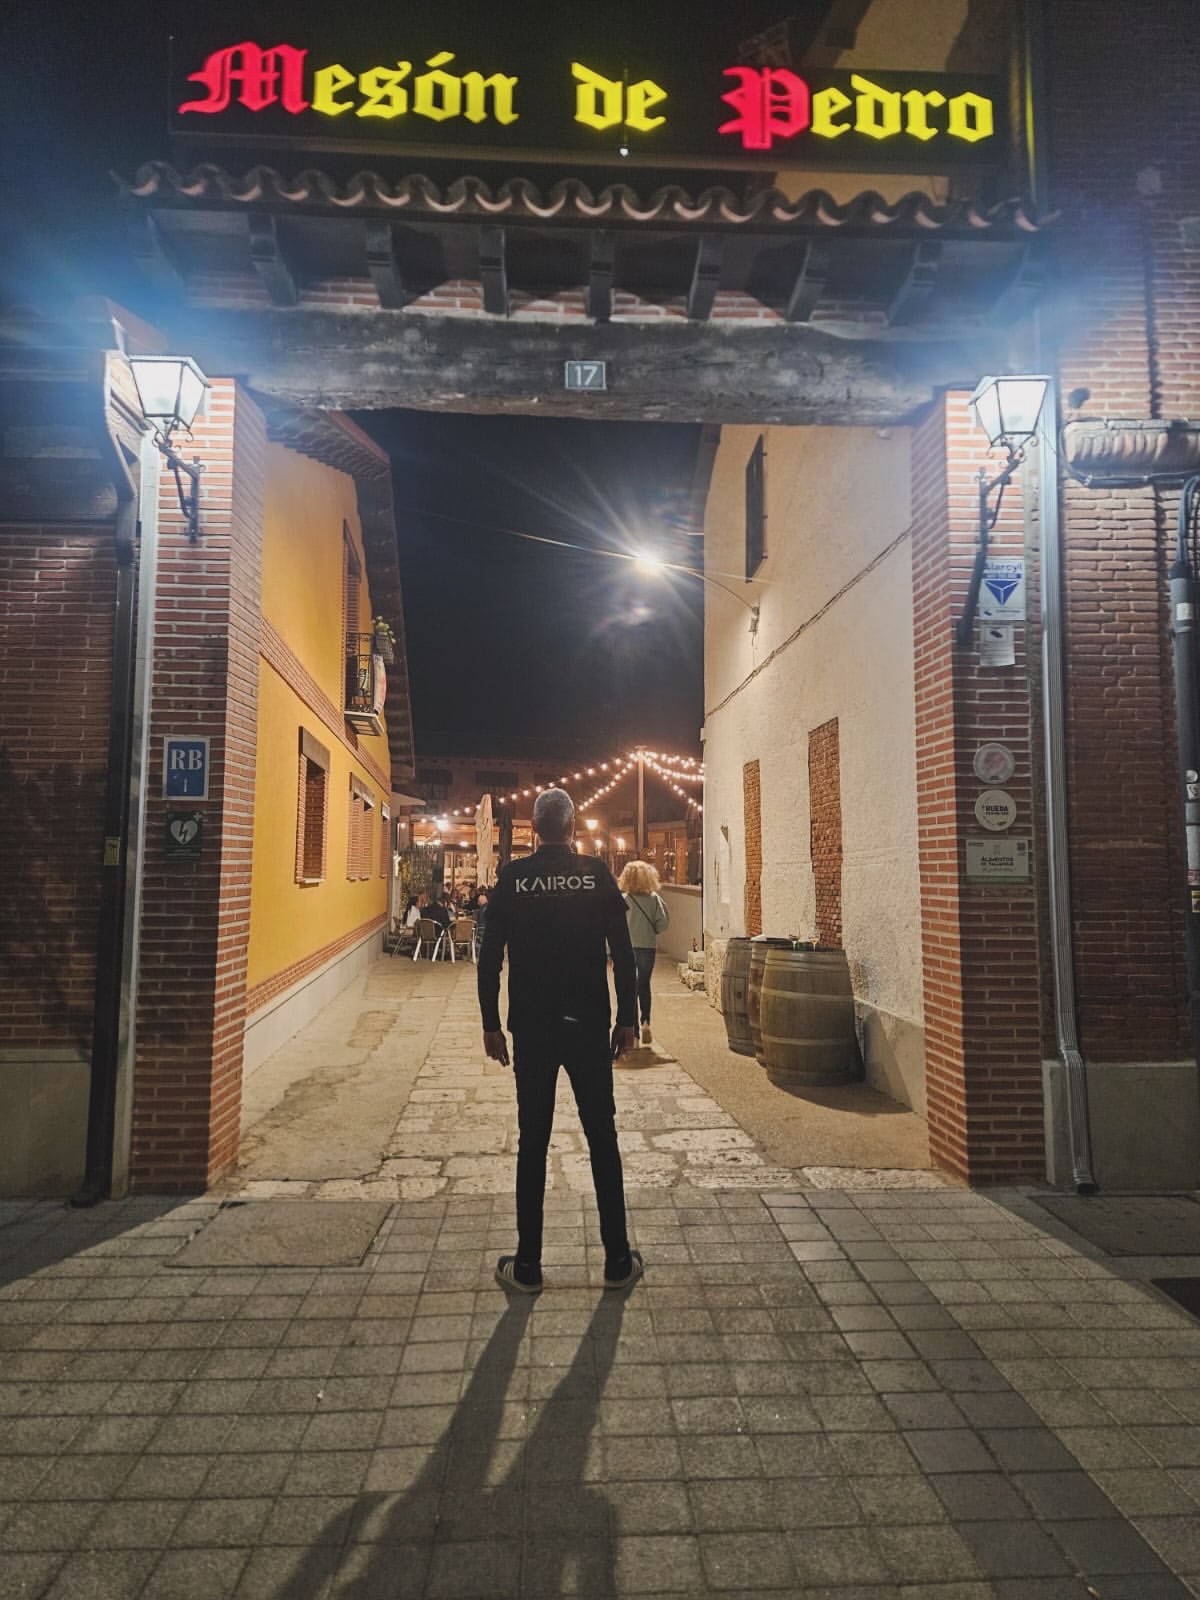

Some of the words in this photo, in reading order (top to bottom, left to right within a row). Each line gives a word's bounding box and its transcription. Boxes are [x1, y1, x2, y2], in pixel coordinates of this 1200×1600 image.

[178, 41, 520, 126] Mesón
[571, 62, 668, 132] de
[718, 66, 994, 149] Pedro
[575, 365, 598, 386] 17
[170, 749, 203, 770] RB
[515, 876, 596, 893] KAIROS
